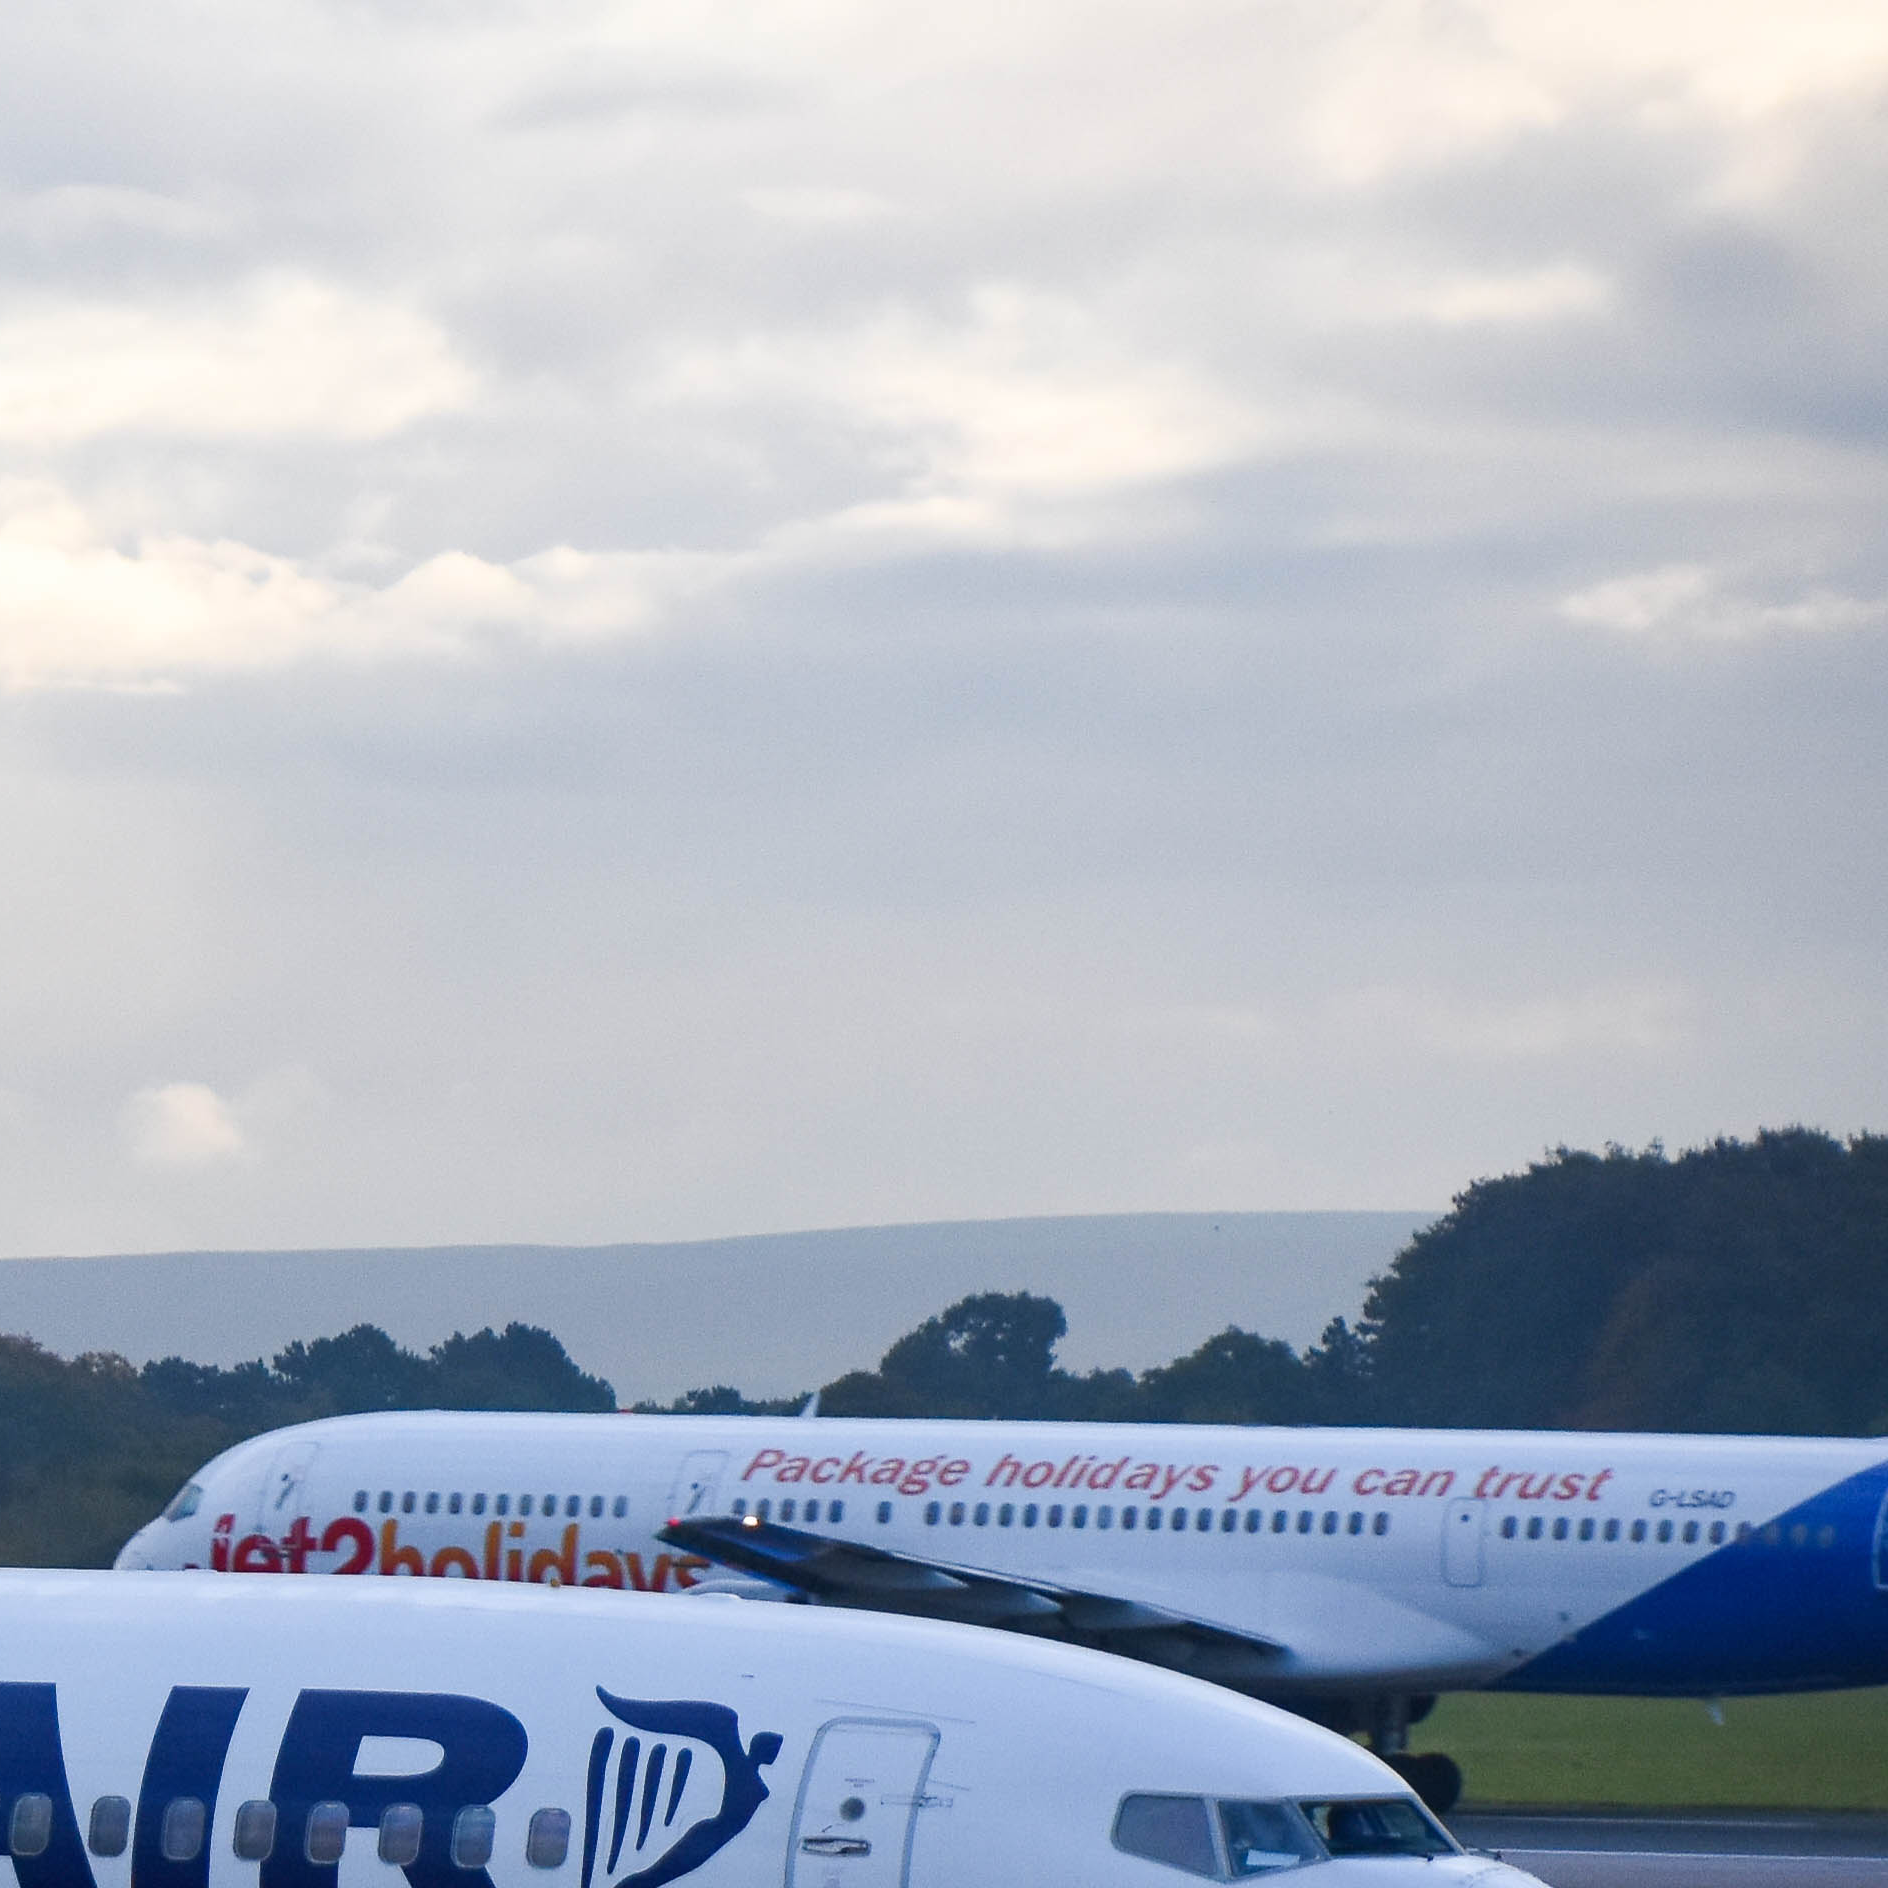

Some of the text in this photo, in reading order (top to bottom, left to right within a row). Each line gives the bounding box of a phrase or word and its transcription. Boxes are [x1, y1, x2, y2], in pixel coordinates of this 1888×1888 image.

[741, 1447, 1617, 1503] Package holidays you can trust
